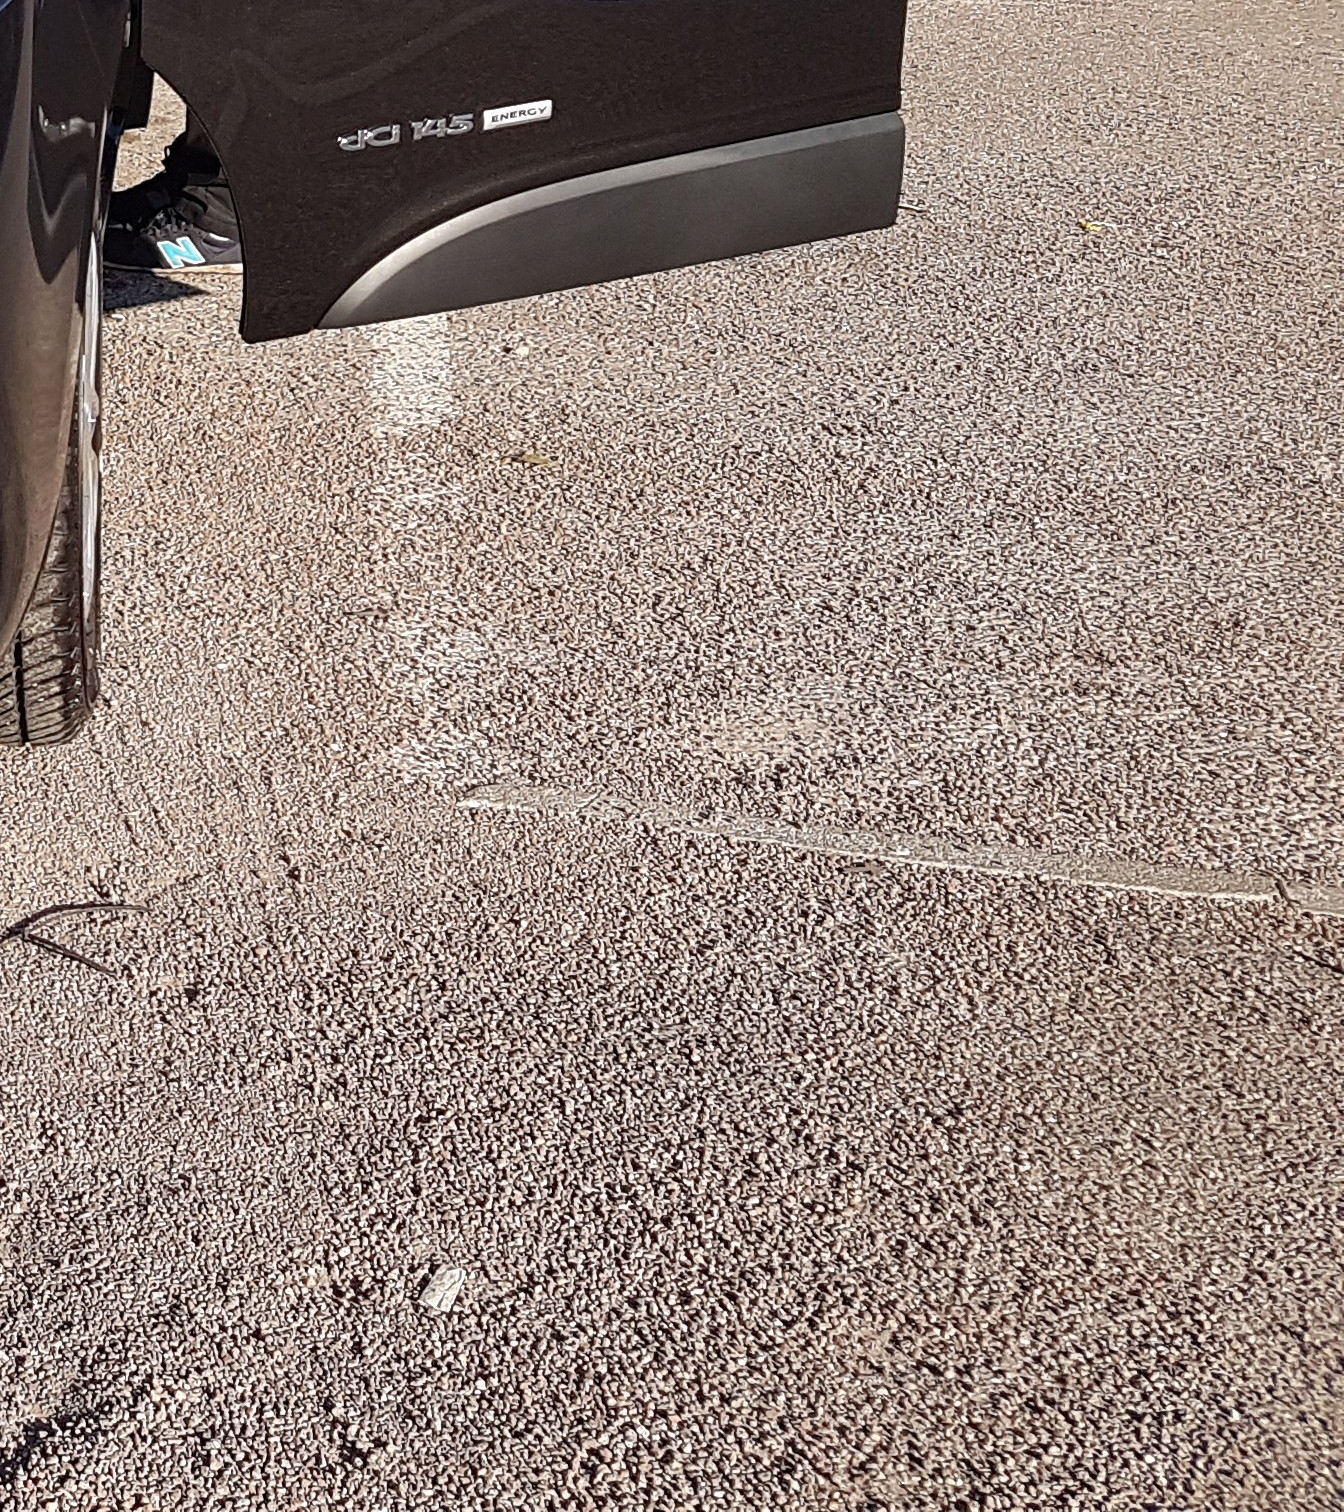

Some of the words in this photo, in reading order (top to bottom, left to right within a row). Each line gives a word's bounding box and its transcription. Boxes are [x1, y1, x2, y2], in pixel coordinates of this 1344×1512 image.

[410, 112, 475, 141] 145
[491, 104, 549, 124] ENERGY
[156, 235, 207, 270] N
